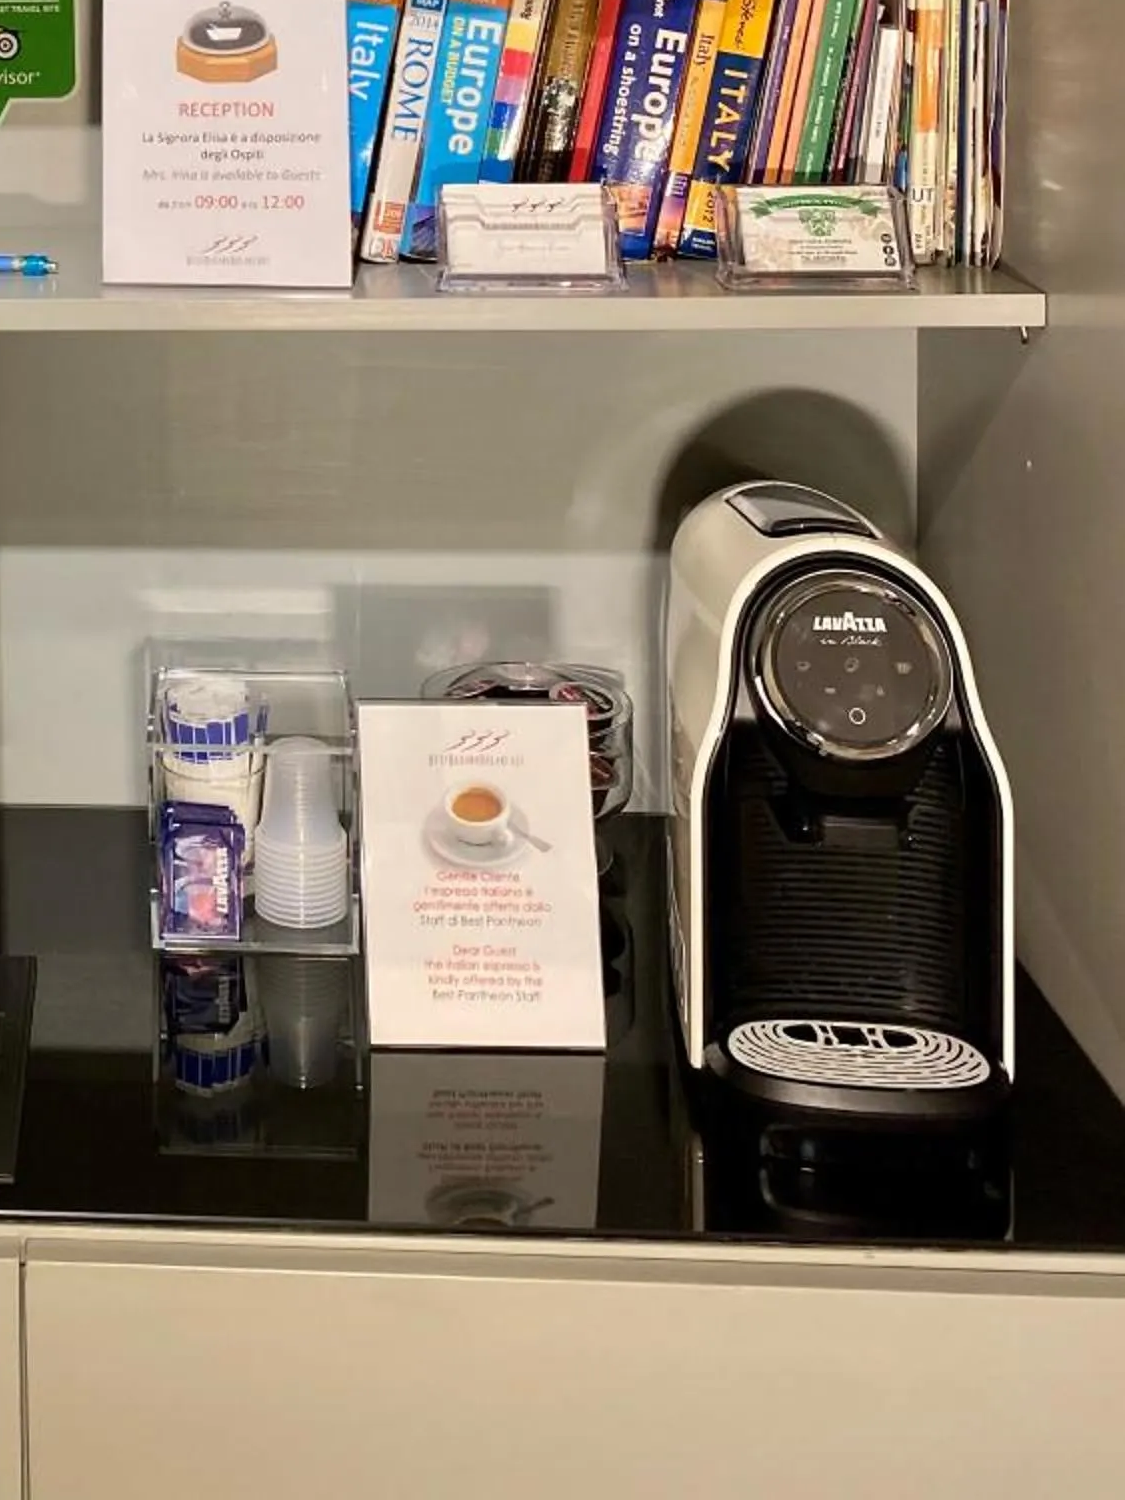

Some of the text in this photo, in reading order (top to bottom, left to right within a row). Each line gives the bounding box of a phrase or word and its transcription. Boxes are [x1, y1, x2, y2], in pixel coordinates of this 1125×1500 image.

[451, 16, 466, 37] ON
[628, 24, 643, 47] on
[349, 20, 390, 101] Italy
[693, 33, 716, 68] Italy
[392, 36, 435, 142] ROME
[440, 52, 458, 106] BUDGET
[448, 17, 505, 156] Europe
[178, 101, 275, 118] RECEPTION
[602, 66, 636, 157] shoestring
[634, 26, 688, 171] Europe
[142, 132, 154, 143] La
[157, 132, 200, 145] Signora
[250, 131, 321, 145] disposizione
[705, 67, 750, 176] ITALY
[200, 150, 265, 163] degli Ospiti
[194, 194, 239, 210] 09:00
[262, 194, 305, 210] 12:00
[702, 190, 715, 223] 2012
[812, 611, 888, 633] LAVAZZA
